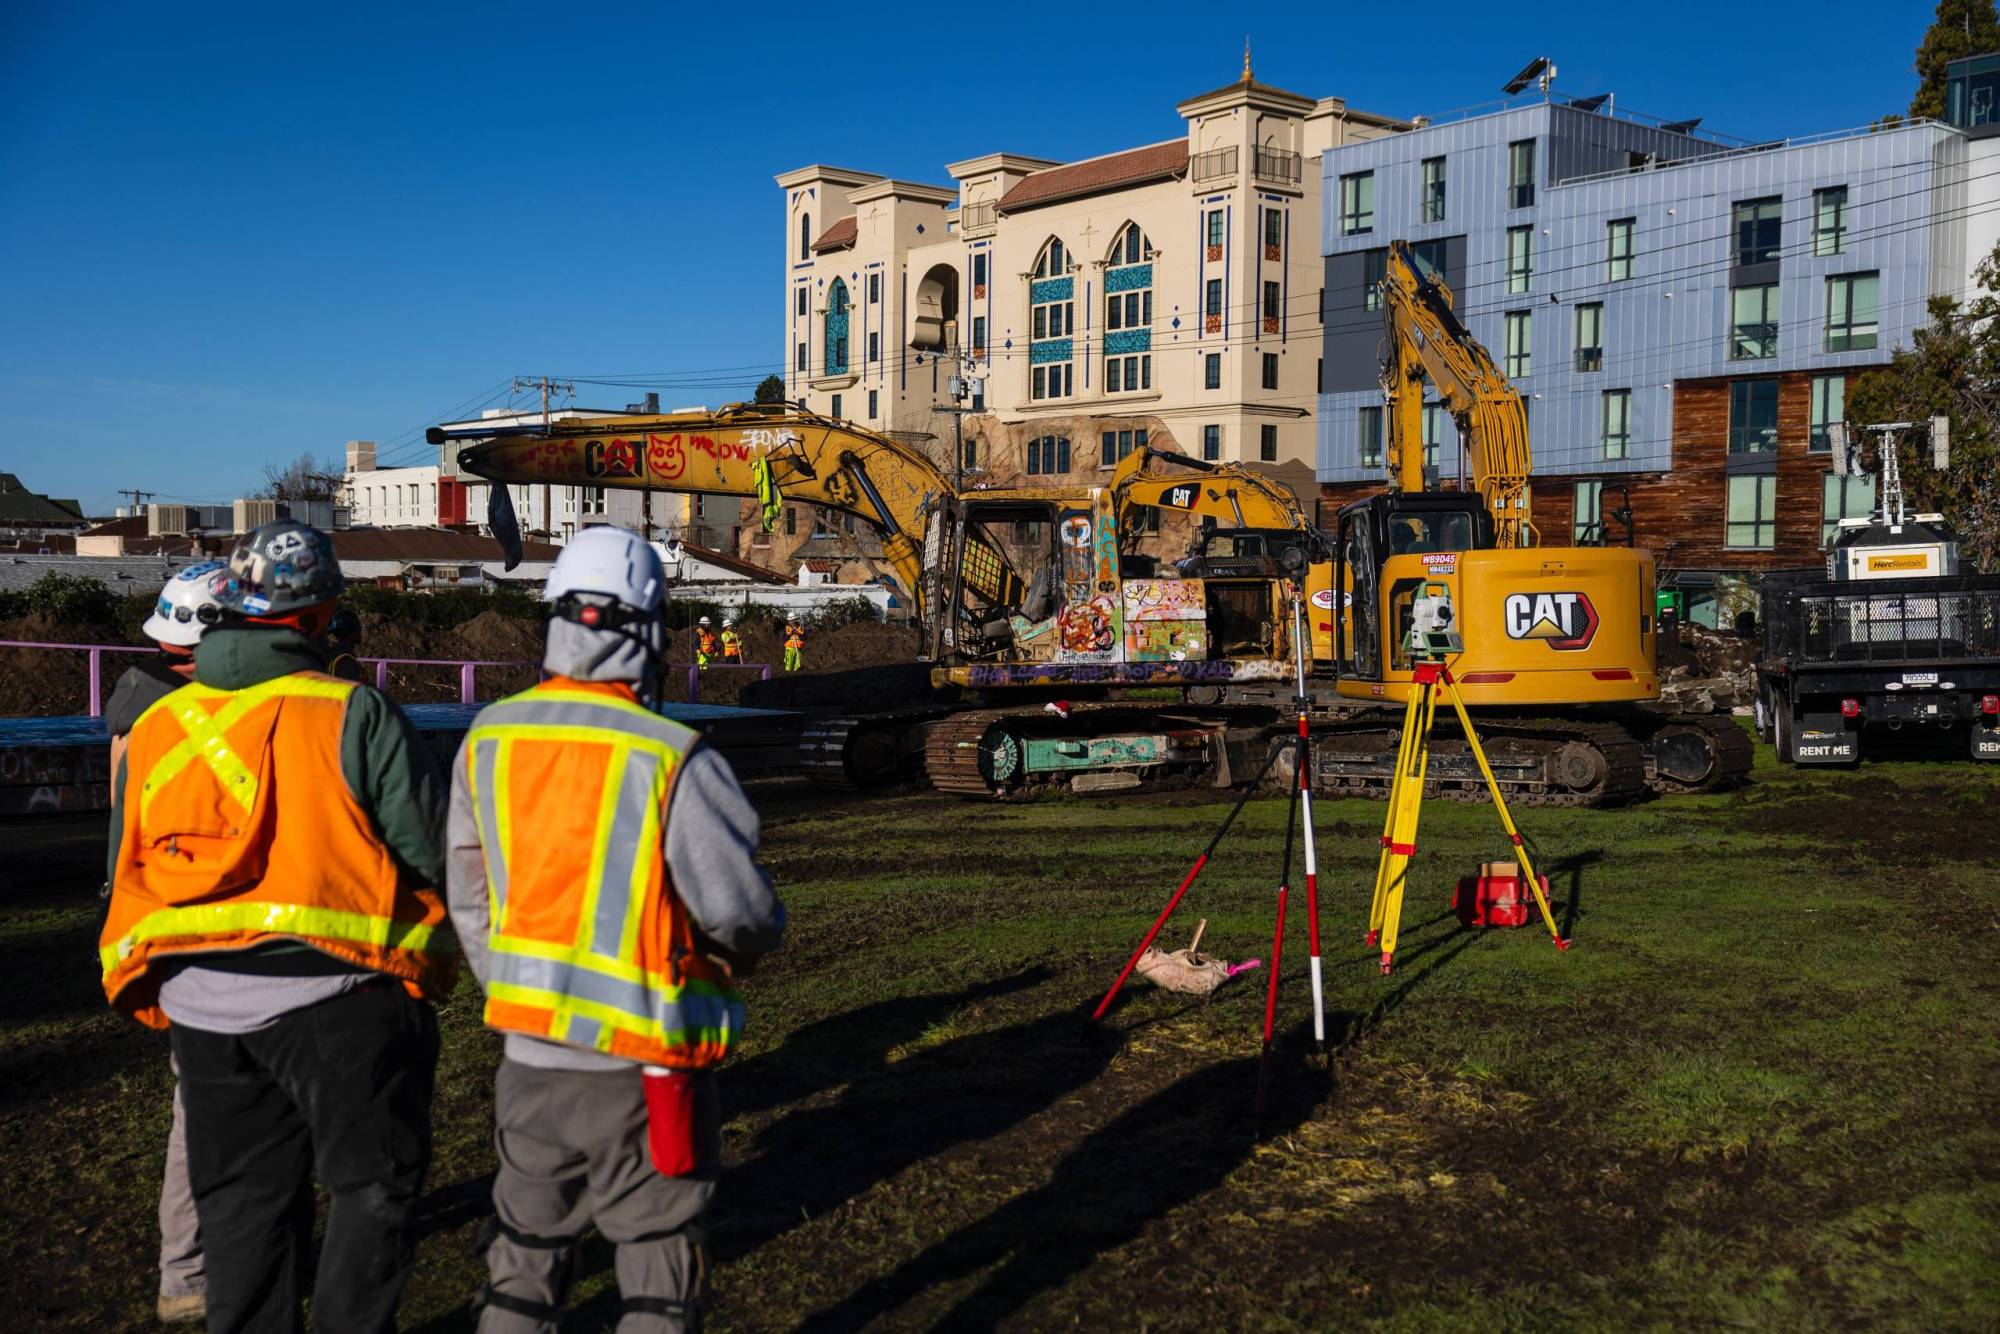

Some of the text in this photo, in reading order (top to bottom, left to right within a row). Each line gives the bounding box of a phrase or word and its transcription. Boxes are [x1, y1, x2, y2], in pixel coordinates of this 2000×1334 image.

[1172, 487, 1191, 507] CAT
[1422, 554, 1456, 564] WB9D45
[1506, 593, 1577, 638] CAT
[1799, 745, 1850, 756] RENT ME
